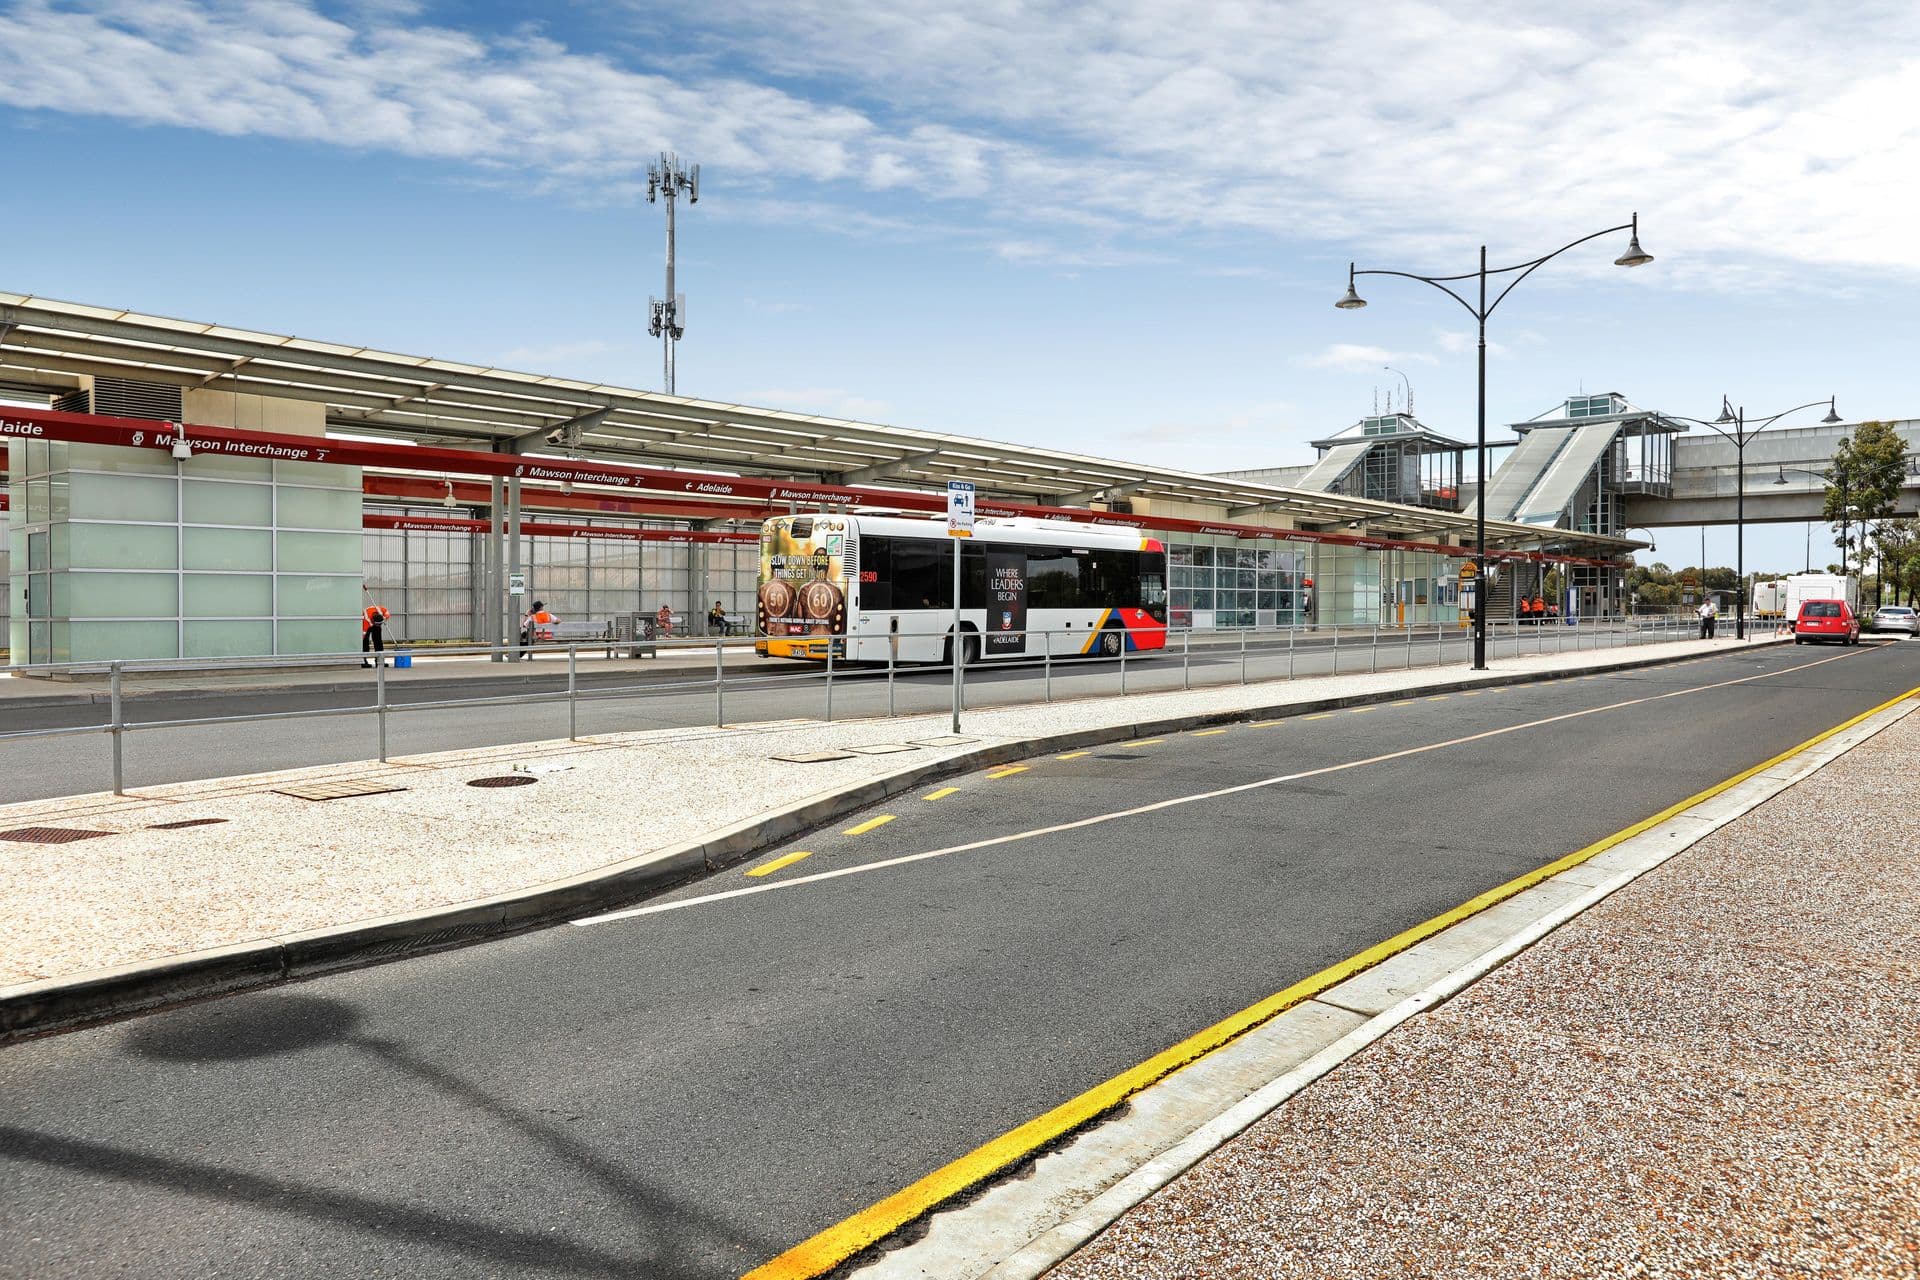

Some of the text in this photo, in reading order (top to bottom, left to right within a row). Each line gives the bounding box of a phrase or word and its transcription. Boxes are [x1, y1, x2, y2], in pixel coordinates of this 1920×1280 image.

[225, 440, 308, 459] Interchange
[317, 452, 325, 460] 2
[529, 466, 572, 480] Mawson
[574, 471, 630, 485] Interchange
[696, 482, 733, 494] Adelaide
[780, 489, 811, 500] Mawson
[811, 492, 852, 503] Interchange
[403, 522, 432, 530] Mawson
[433, 523, 472, 532] Interchange
[604, 531, 635, 540] Interchange
[771, 554, 829, 566] SLOW DOWN BEFORE
[775, 568, 795, 579] THINGS
[796, 568, 807, 579] GET
[860, 571, 877, 582] 2590
[995, 568, 1019, 578] WHERE
[991, 578, 1023, 590] LEADERS
[770, 592, 783, 607] 50
[813, 593, 827, 607] 60
[997, 591, 1017, 601] BEGIN
